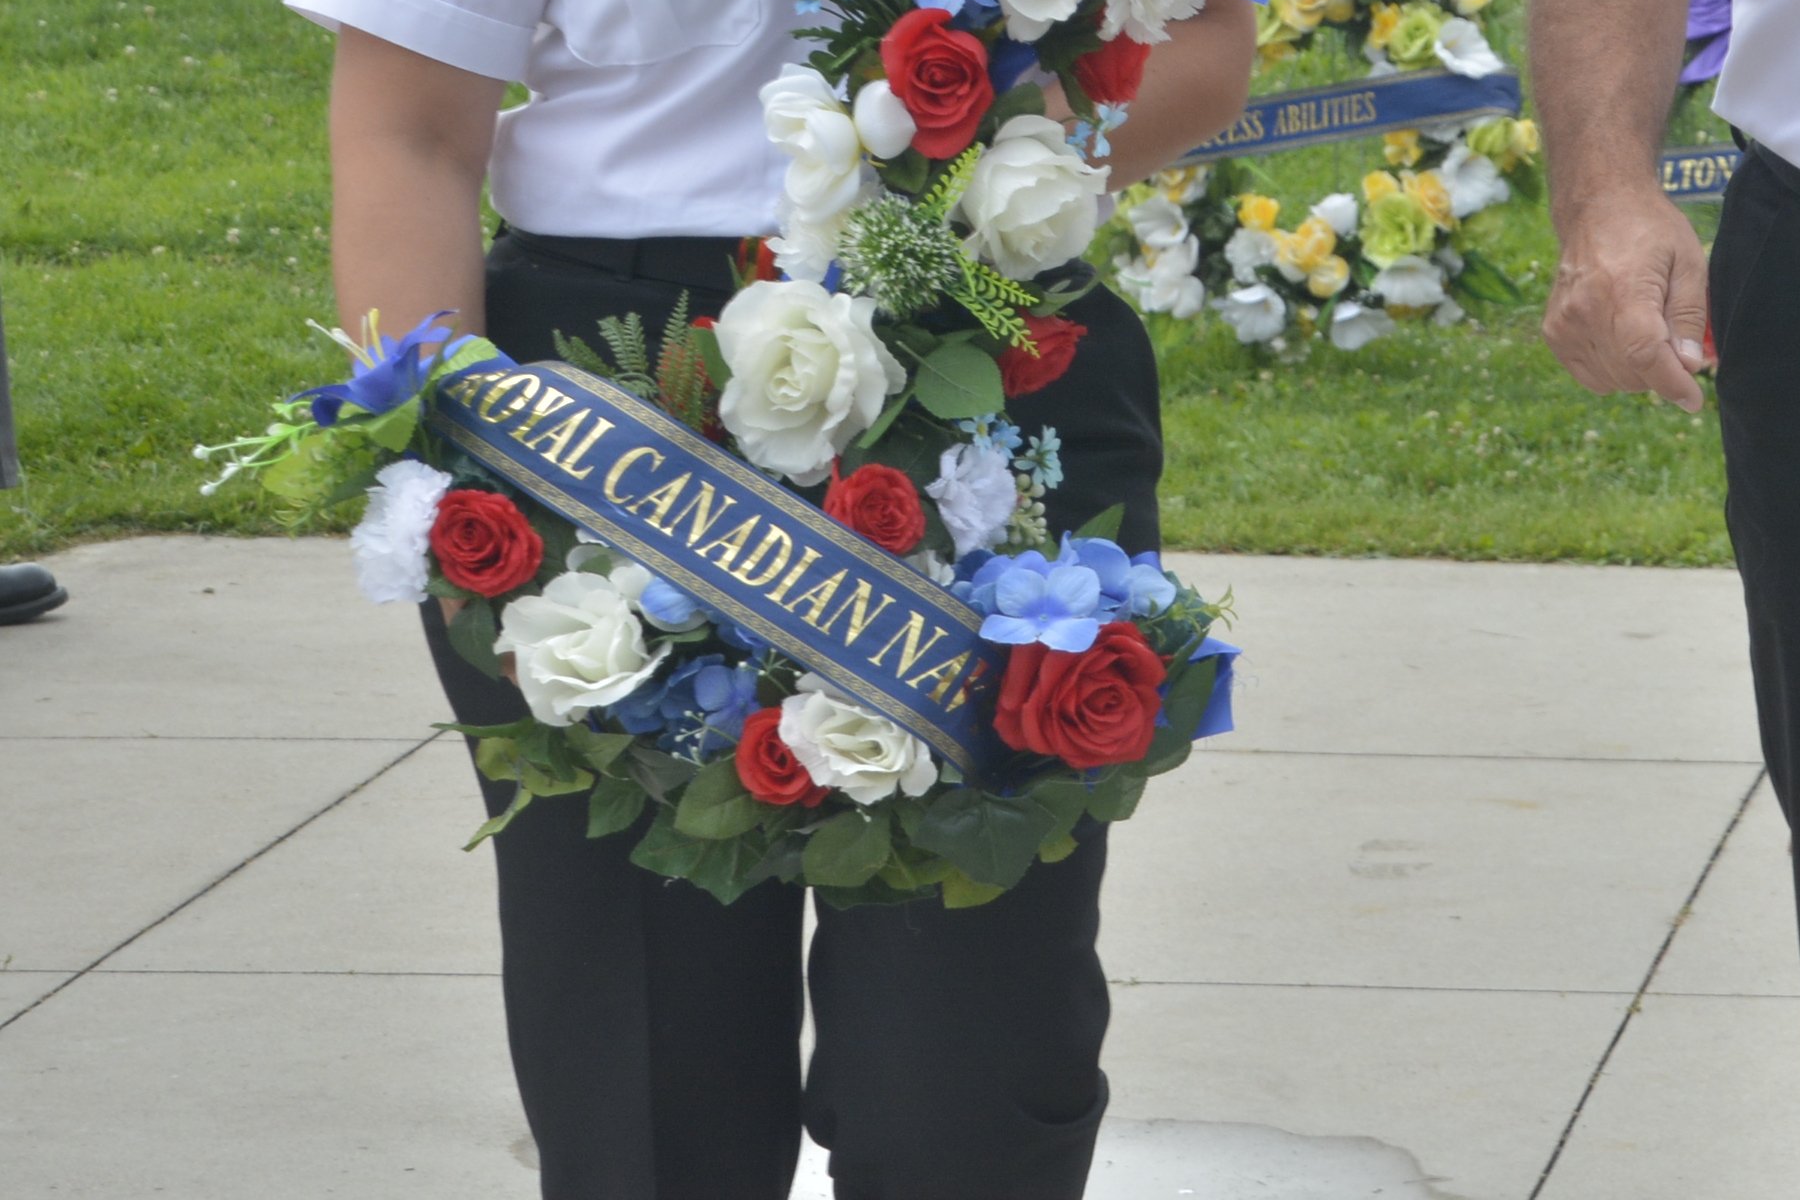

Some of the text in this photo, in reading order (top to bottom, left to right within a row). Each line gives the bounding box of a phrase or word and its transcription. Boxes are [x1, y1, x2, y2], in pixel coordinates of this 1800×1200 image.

[1273, 91, 1377, 137] ABILITIES
[1657, 154, 1738, 192] LTON
[604, 446, 896, 648] CANADIAN
